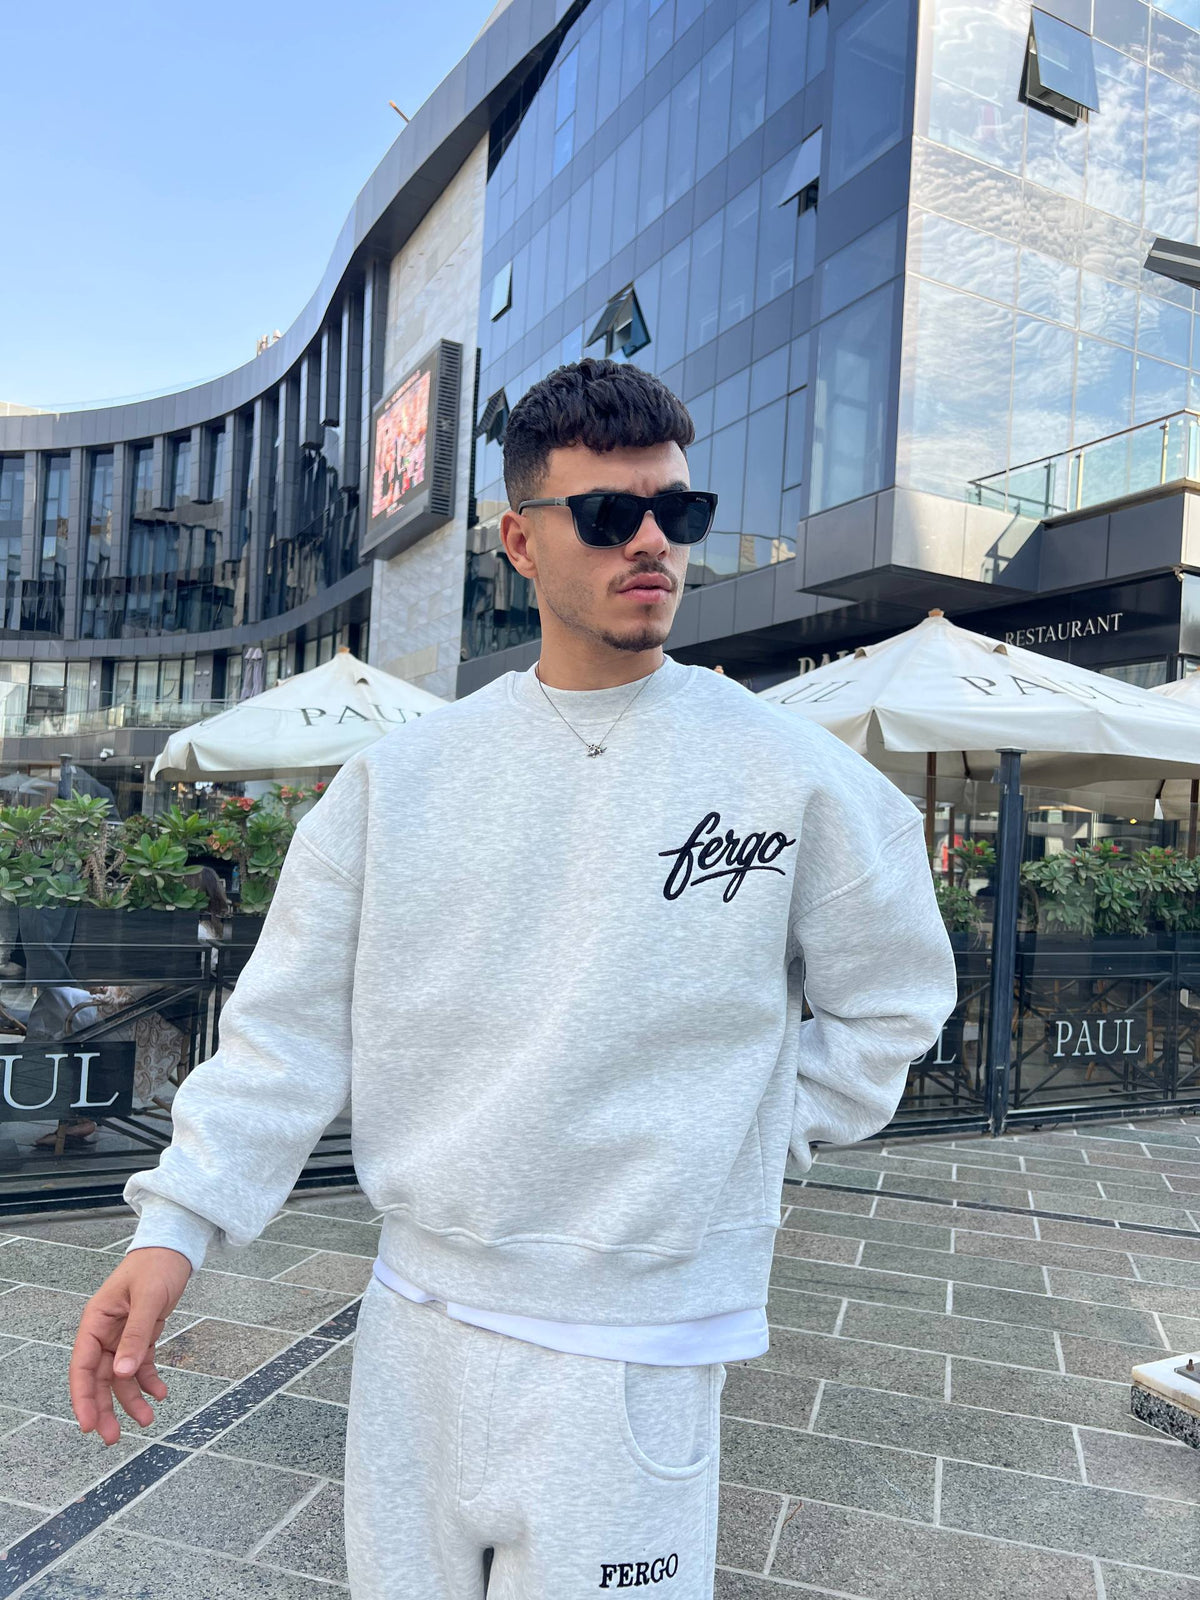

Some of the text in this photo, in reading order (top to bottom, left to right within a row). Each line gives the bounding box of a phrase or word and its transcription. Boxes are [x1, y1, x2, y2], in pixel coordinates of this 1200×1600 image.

[1004, 612, 1124, 648] RESTAURANT
[952, 674, 1142, 707] PAUL
[297, 704, 424, 727] PAU
[658, 811, 797, 903] fergo
[1053, 1018, 1142, 1058] PAUL
[598, 1552, 679, 1589] FERGO
